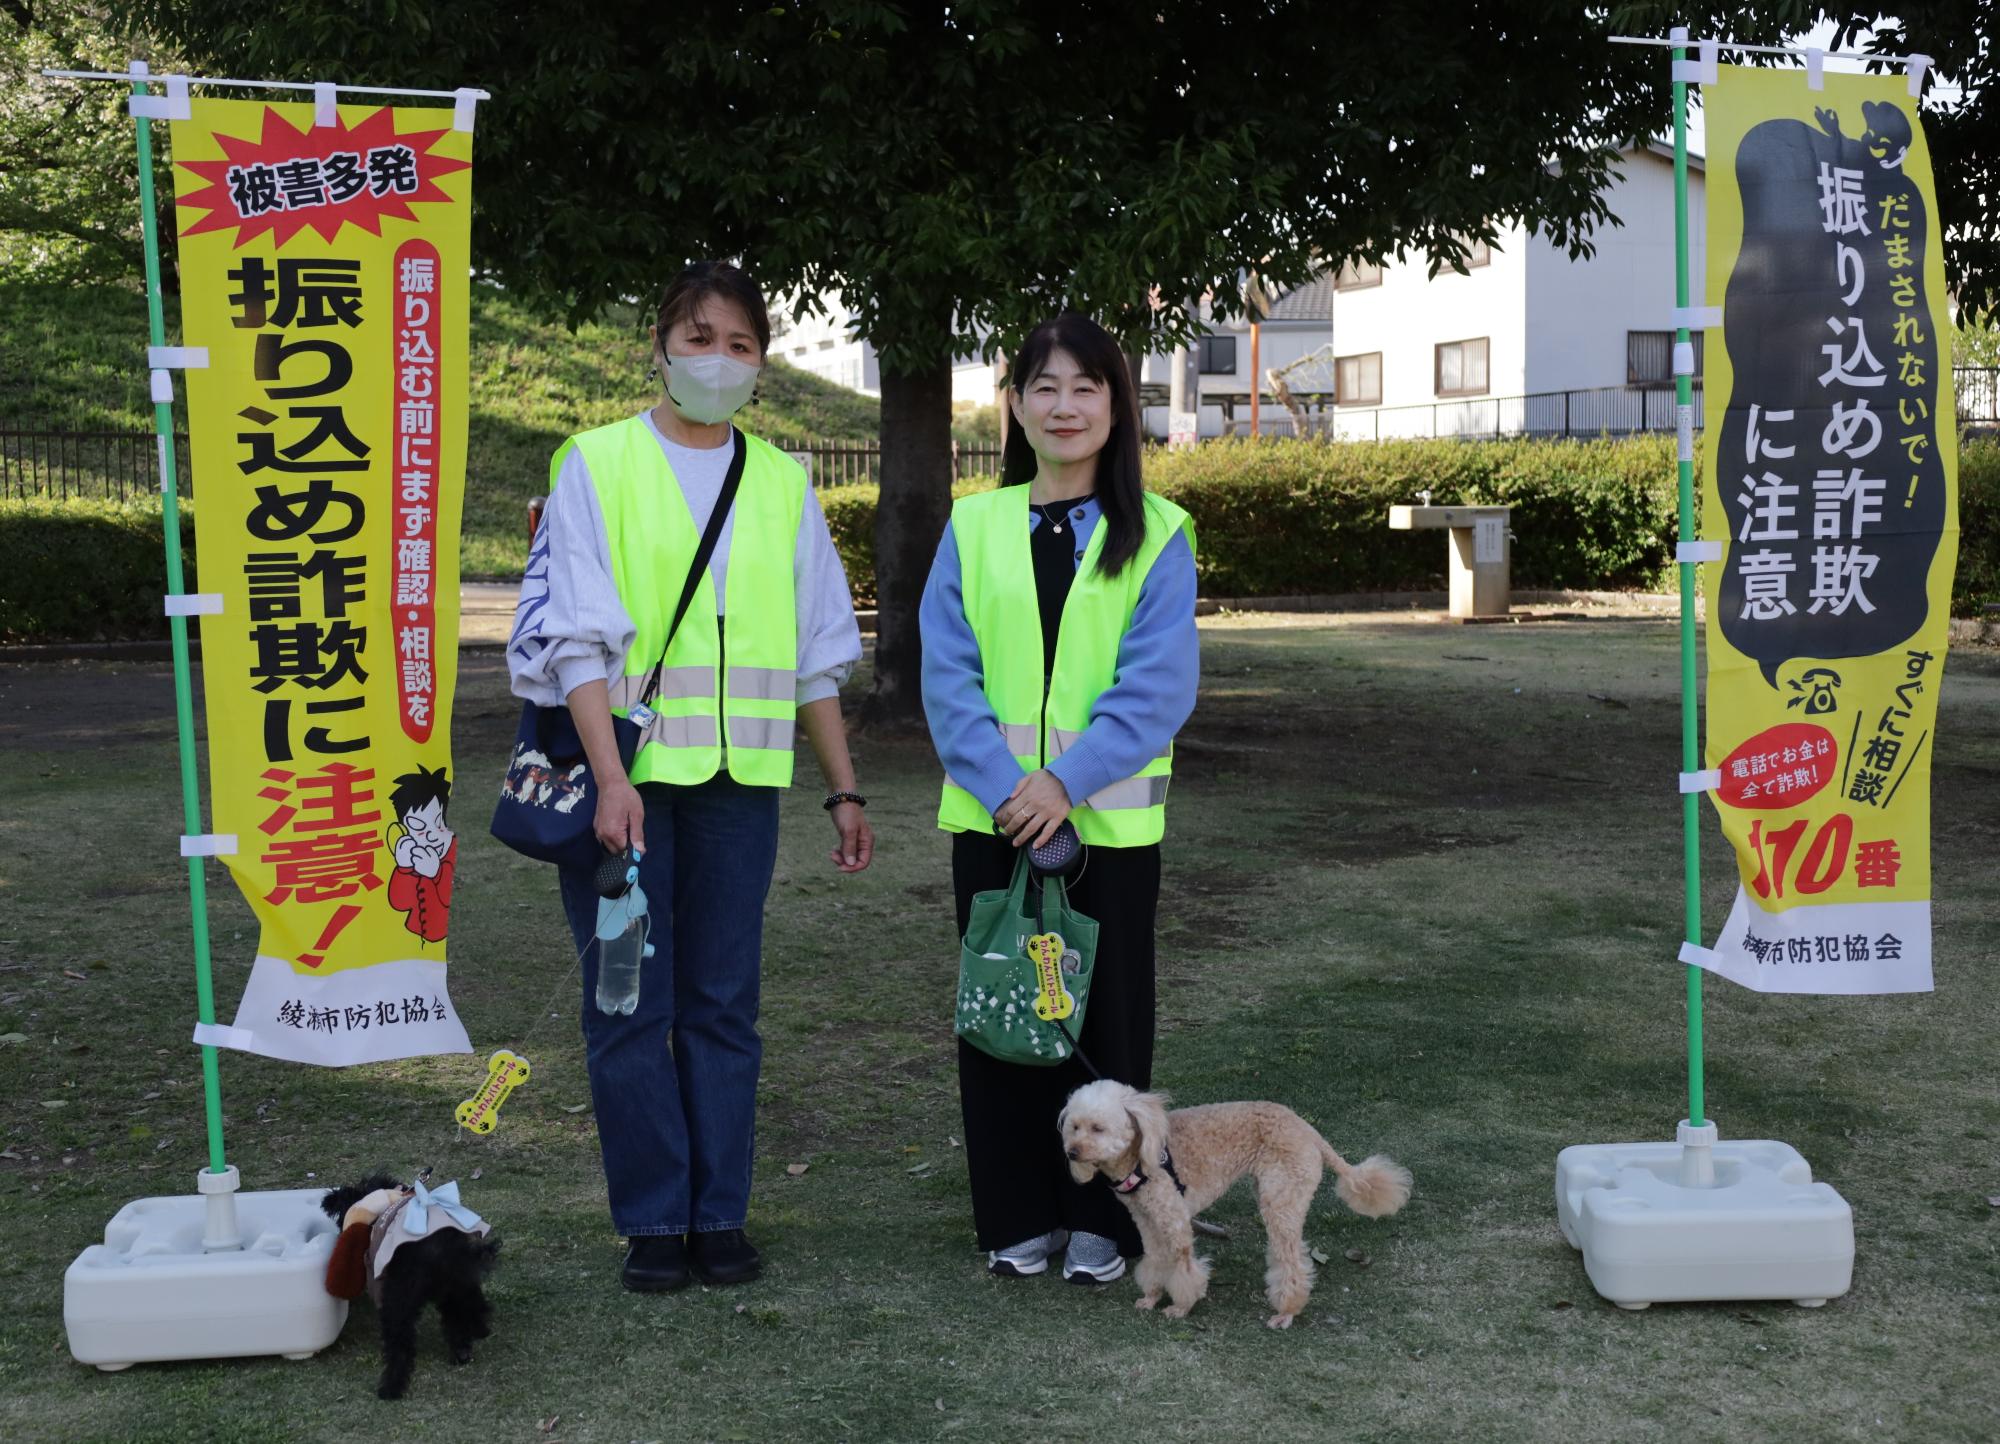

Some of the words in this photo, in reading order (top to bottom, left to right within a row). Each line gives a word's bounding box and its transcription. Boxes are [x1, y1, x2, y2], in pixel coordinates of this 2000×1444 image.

[230, 145, 418, 217] 被害多発
[1807, 162, 1887, 615] 振り込め詐欺
[397, 258, 434, 727] 振り込む前にまず確認・相談を
[1737, 403, 1799, 621] に注意
[1731, 738, 1829, 778] 電話でお金は
[1849, 650, 1934, 807] すぐに相談
[1740, 764, 1818, 800] 全て詐欺！
[1039, 939, 1059, 1014] わんわんパトロール
[468, 1061, 517, 1125] わんわんパトロール
